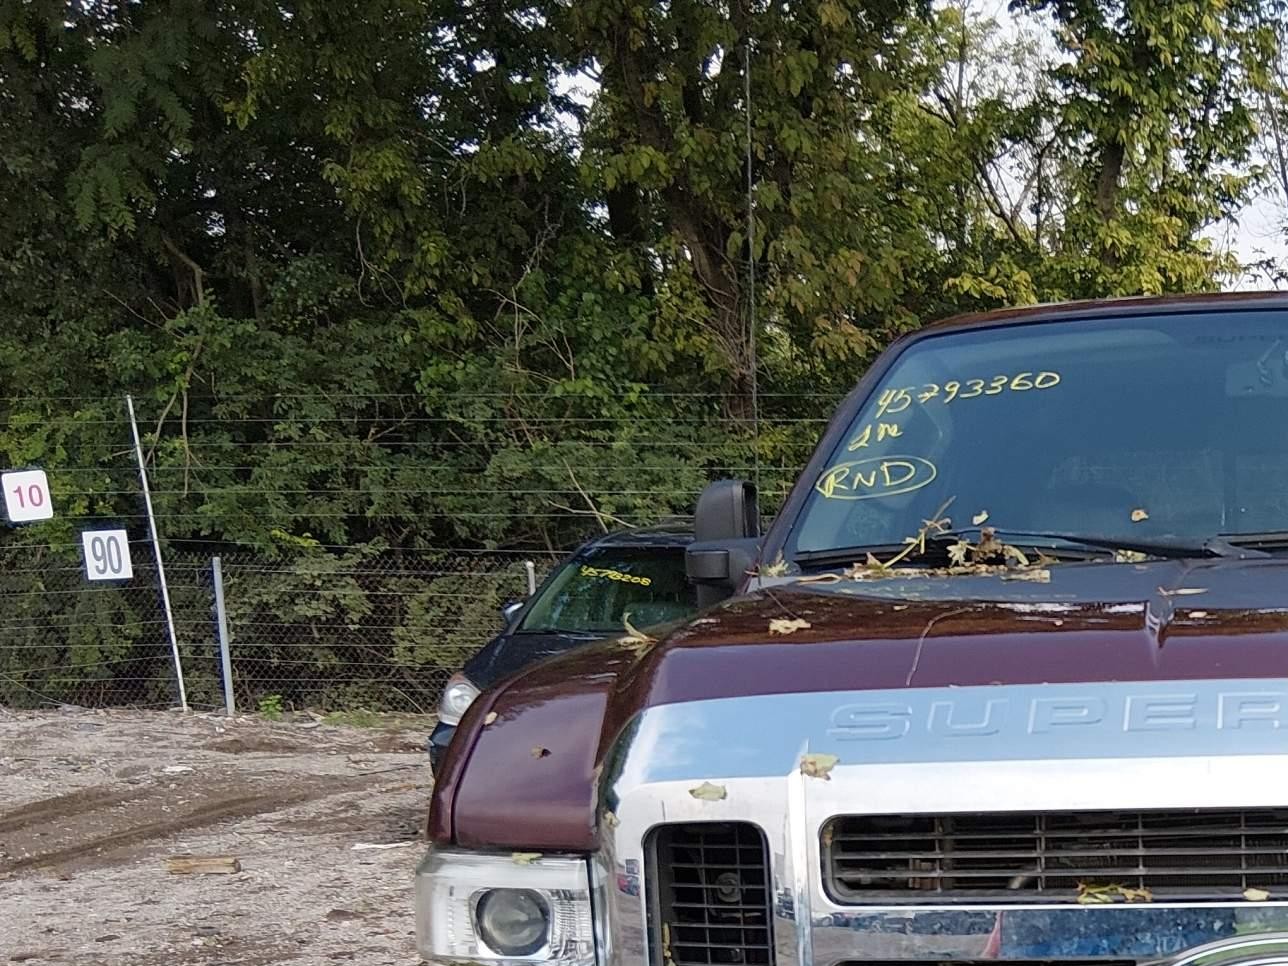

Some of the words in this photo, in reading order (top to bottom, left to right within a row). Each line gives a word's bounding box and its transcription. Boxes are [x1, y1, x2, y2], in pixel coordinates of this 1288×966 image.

[13, 484, 44, 508] 10
[823, 461, 917, 498] RND
[91, 535, 123, 575] 90
